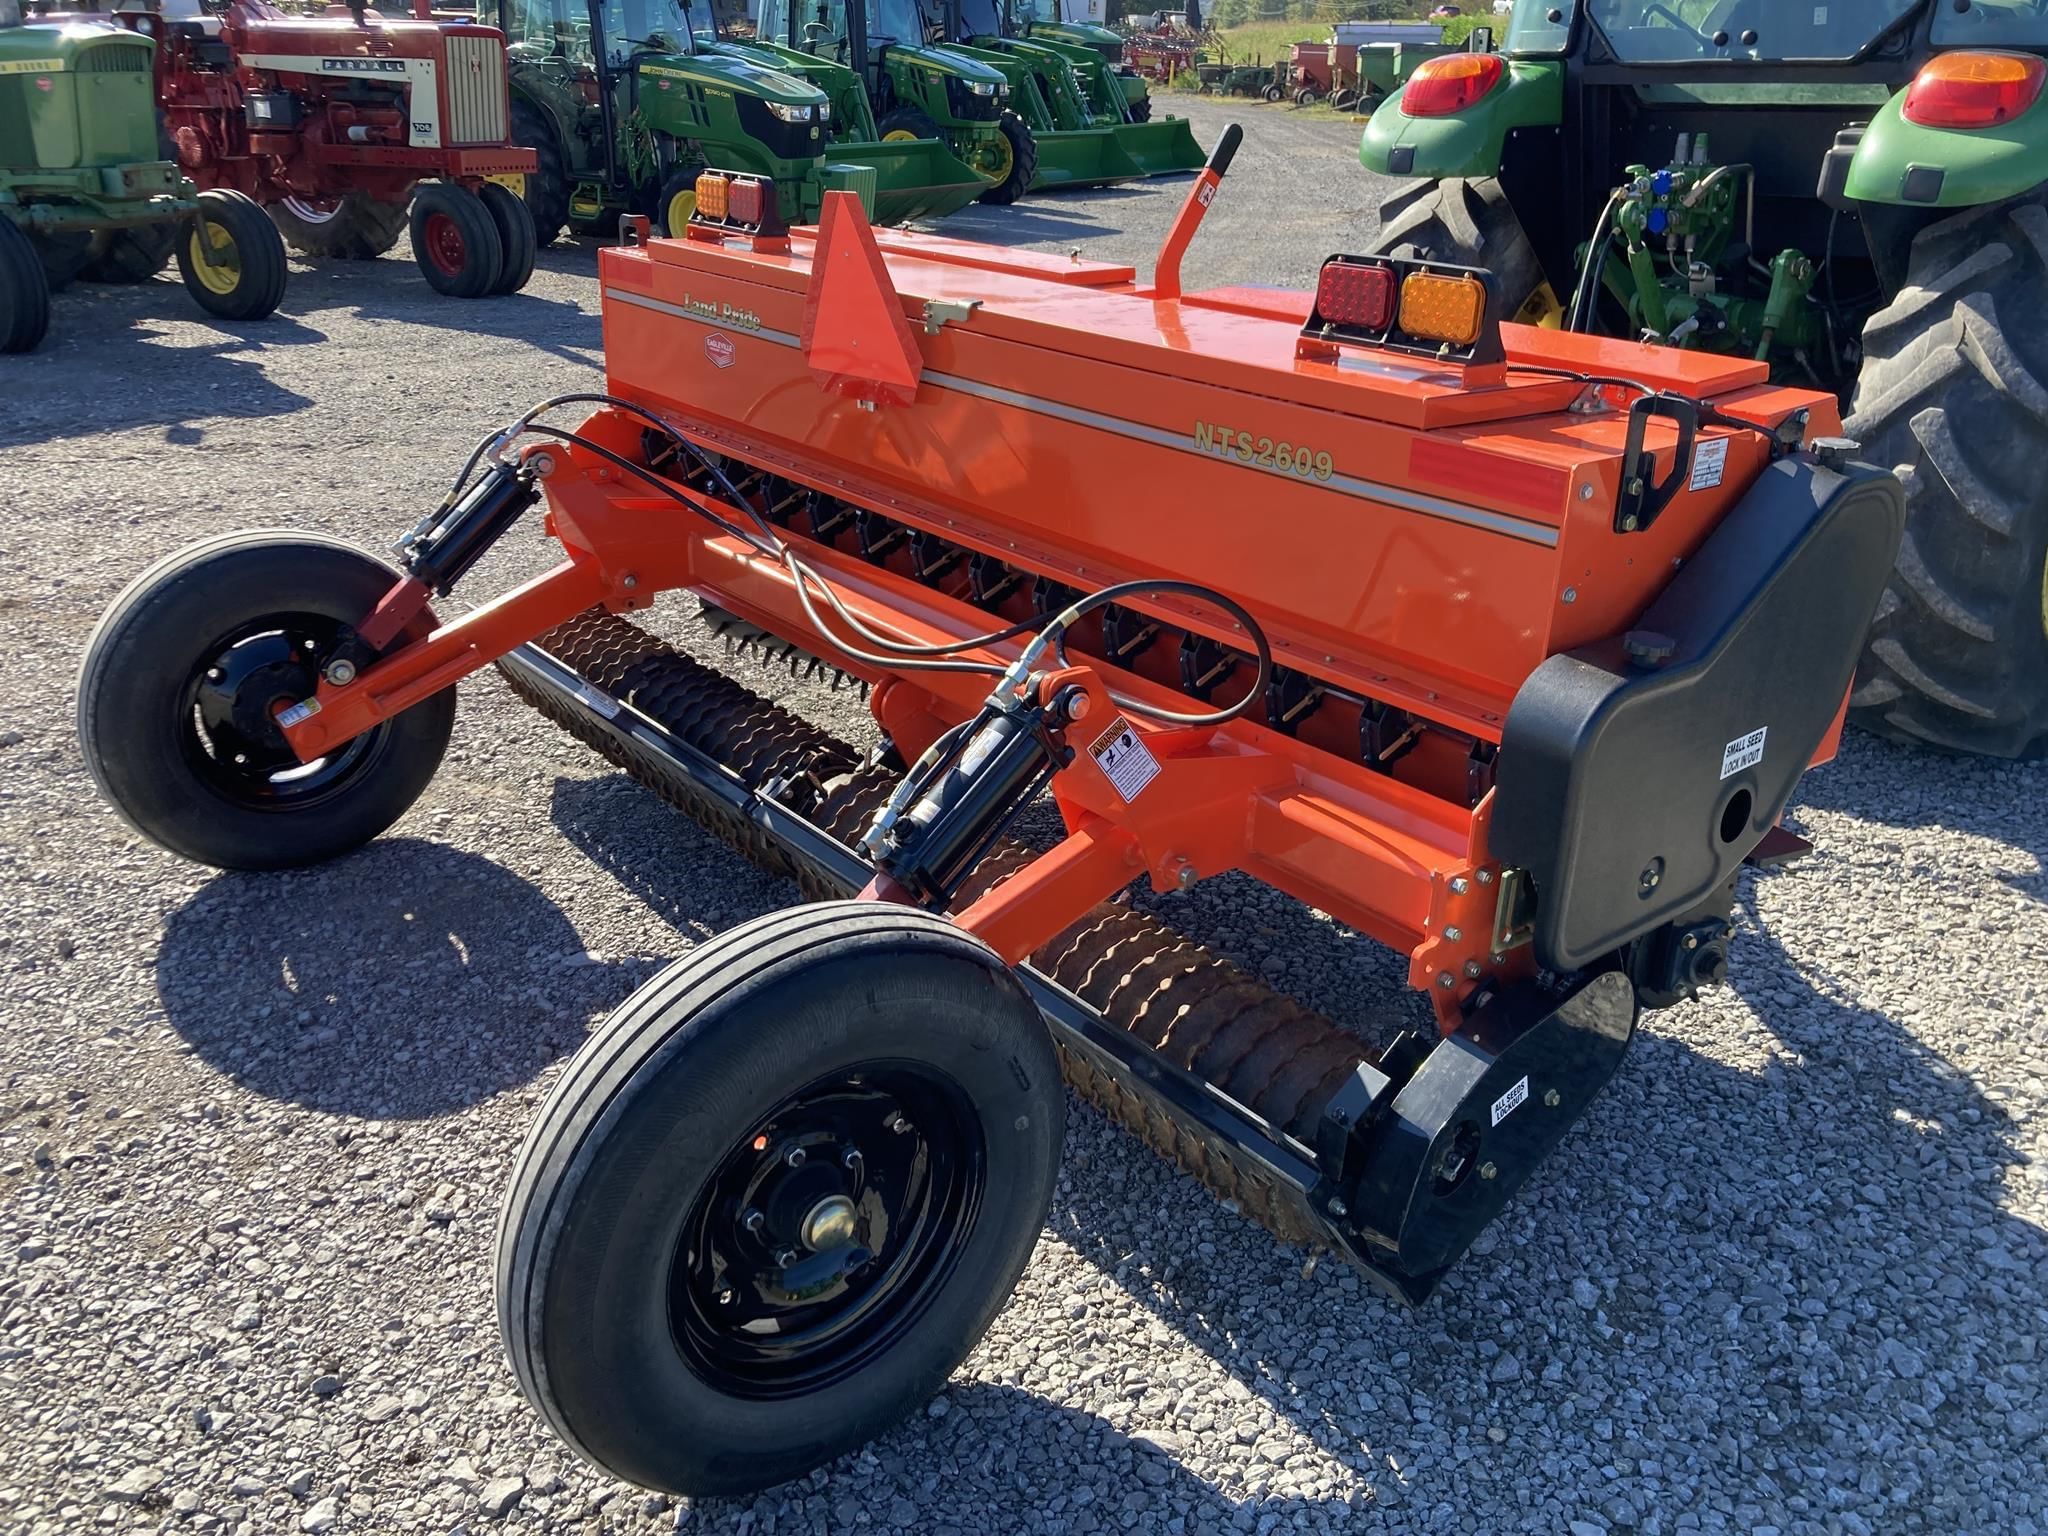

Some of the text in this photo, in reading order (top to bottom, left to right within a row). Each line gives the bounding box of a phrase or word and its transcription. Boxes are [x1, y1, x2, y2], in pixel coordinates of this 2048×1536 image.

[324, 61, 405, 71] FARMALL
[684, 292, 761, 332] Land Pride
[1194, 420, 1334, 481] NTS2609
[1098, 720, 1127, 749] WARNING
[1726, 731, 1763, 757] SMALL SEED
[1495, 1081, 1524, 1112] ALL SEEDS
